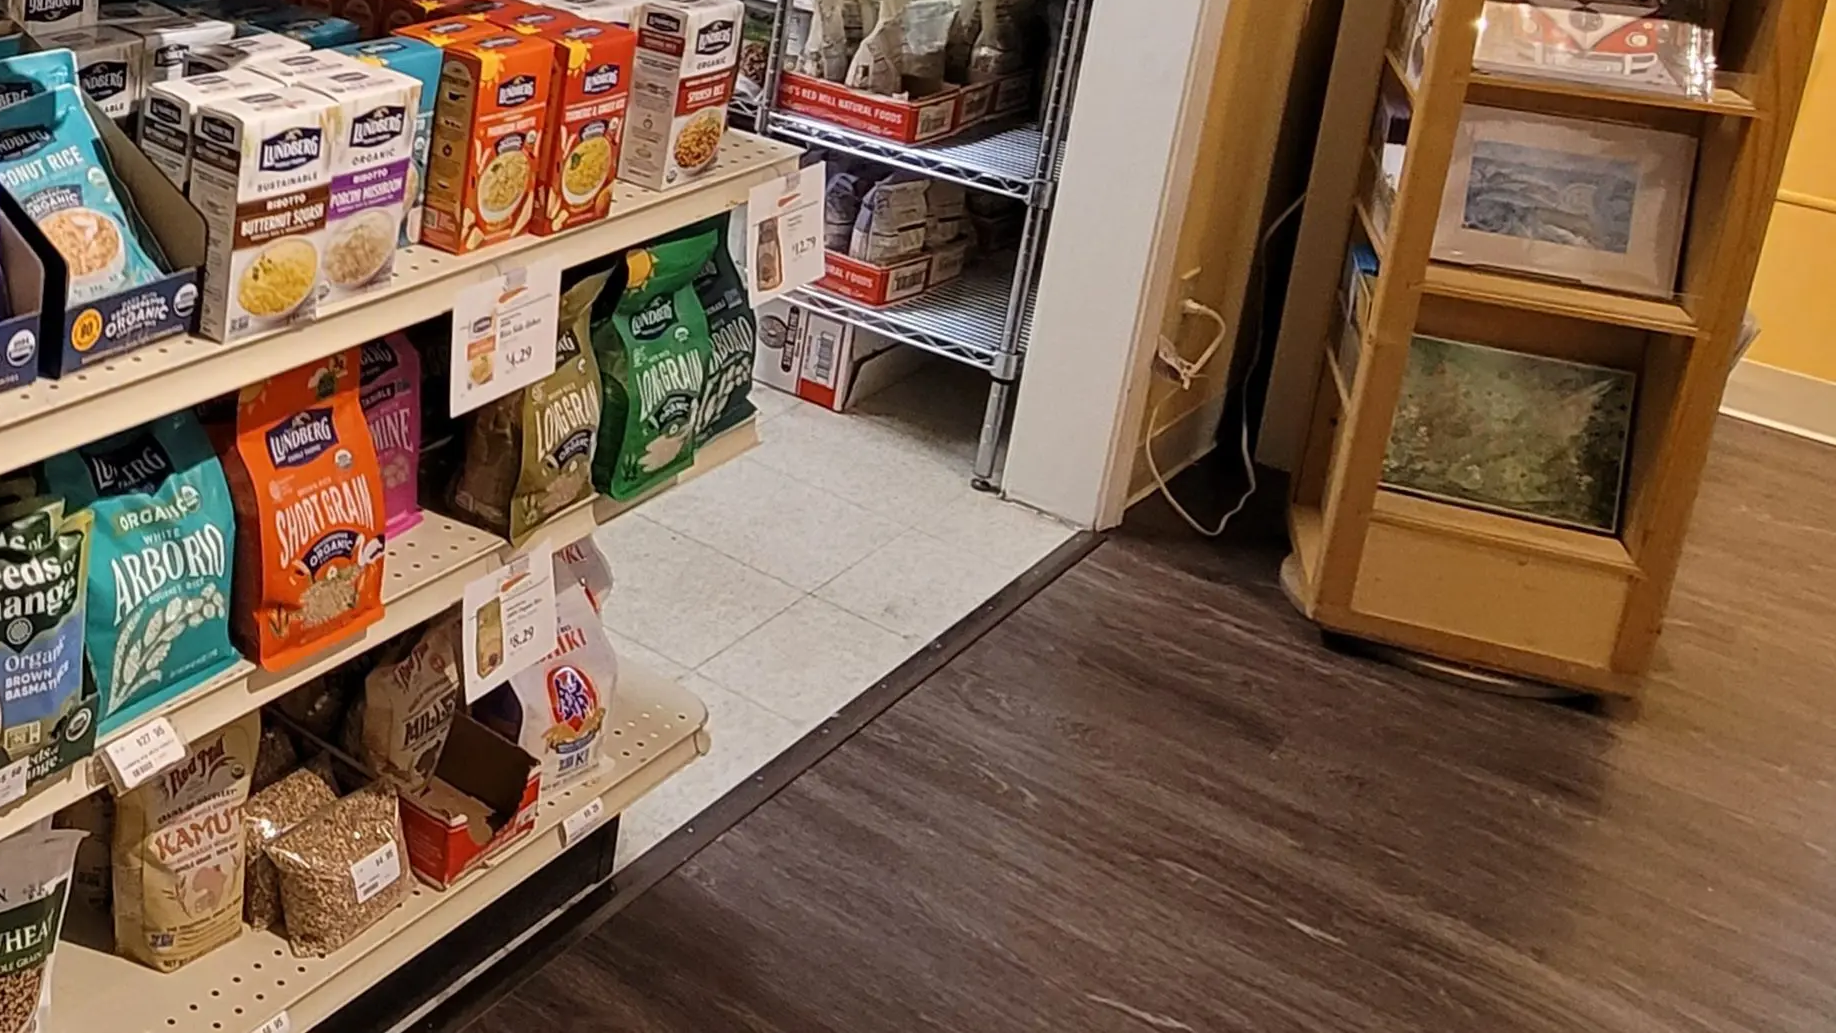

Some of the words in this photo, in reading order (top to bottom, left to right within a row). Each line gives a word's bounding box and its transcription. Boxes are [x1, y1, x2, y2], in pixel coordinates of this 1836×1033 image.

[83, 70, 124, 89] NDBERG
[874, 108, 903, 125] FOODS
[47, 145, 84, 171] RICE
[262, 134, 319, 167] LUNDBERG
[352, 148, 397, 166] ORGANIC
[257, 172, 318, 193] SUSTAINABLE
[105, 304, 169, 339] ORGANIC
[269, 416, 332, 465] LUNDBERG
[371, 407, 414, 453] MINE
[92, 446, 166, 490] LUERG
[143, 527, 181, 545] WHITE
[275, 493, 326, 569] SHORT
[321, 474, 375, 531] GRAIN
[309, 537, 353, 567] ORGANIC
[111, 523, 225, 626] ARBORIO
[5, 668, 53, 689] BROWN
[155, 806, 246, 861] KAMUT
[16, 951, 43, 967] GRAIN
